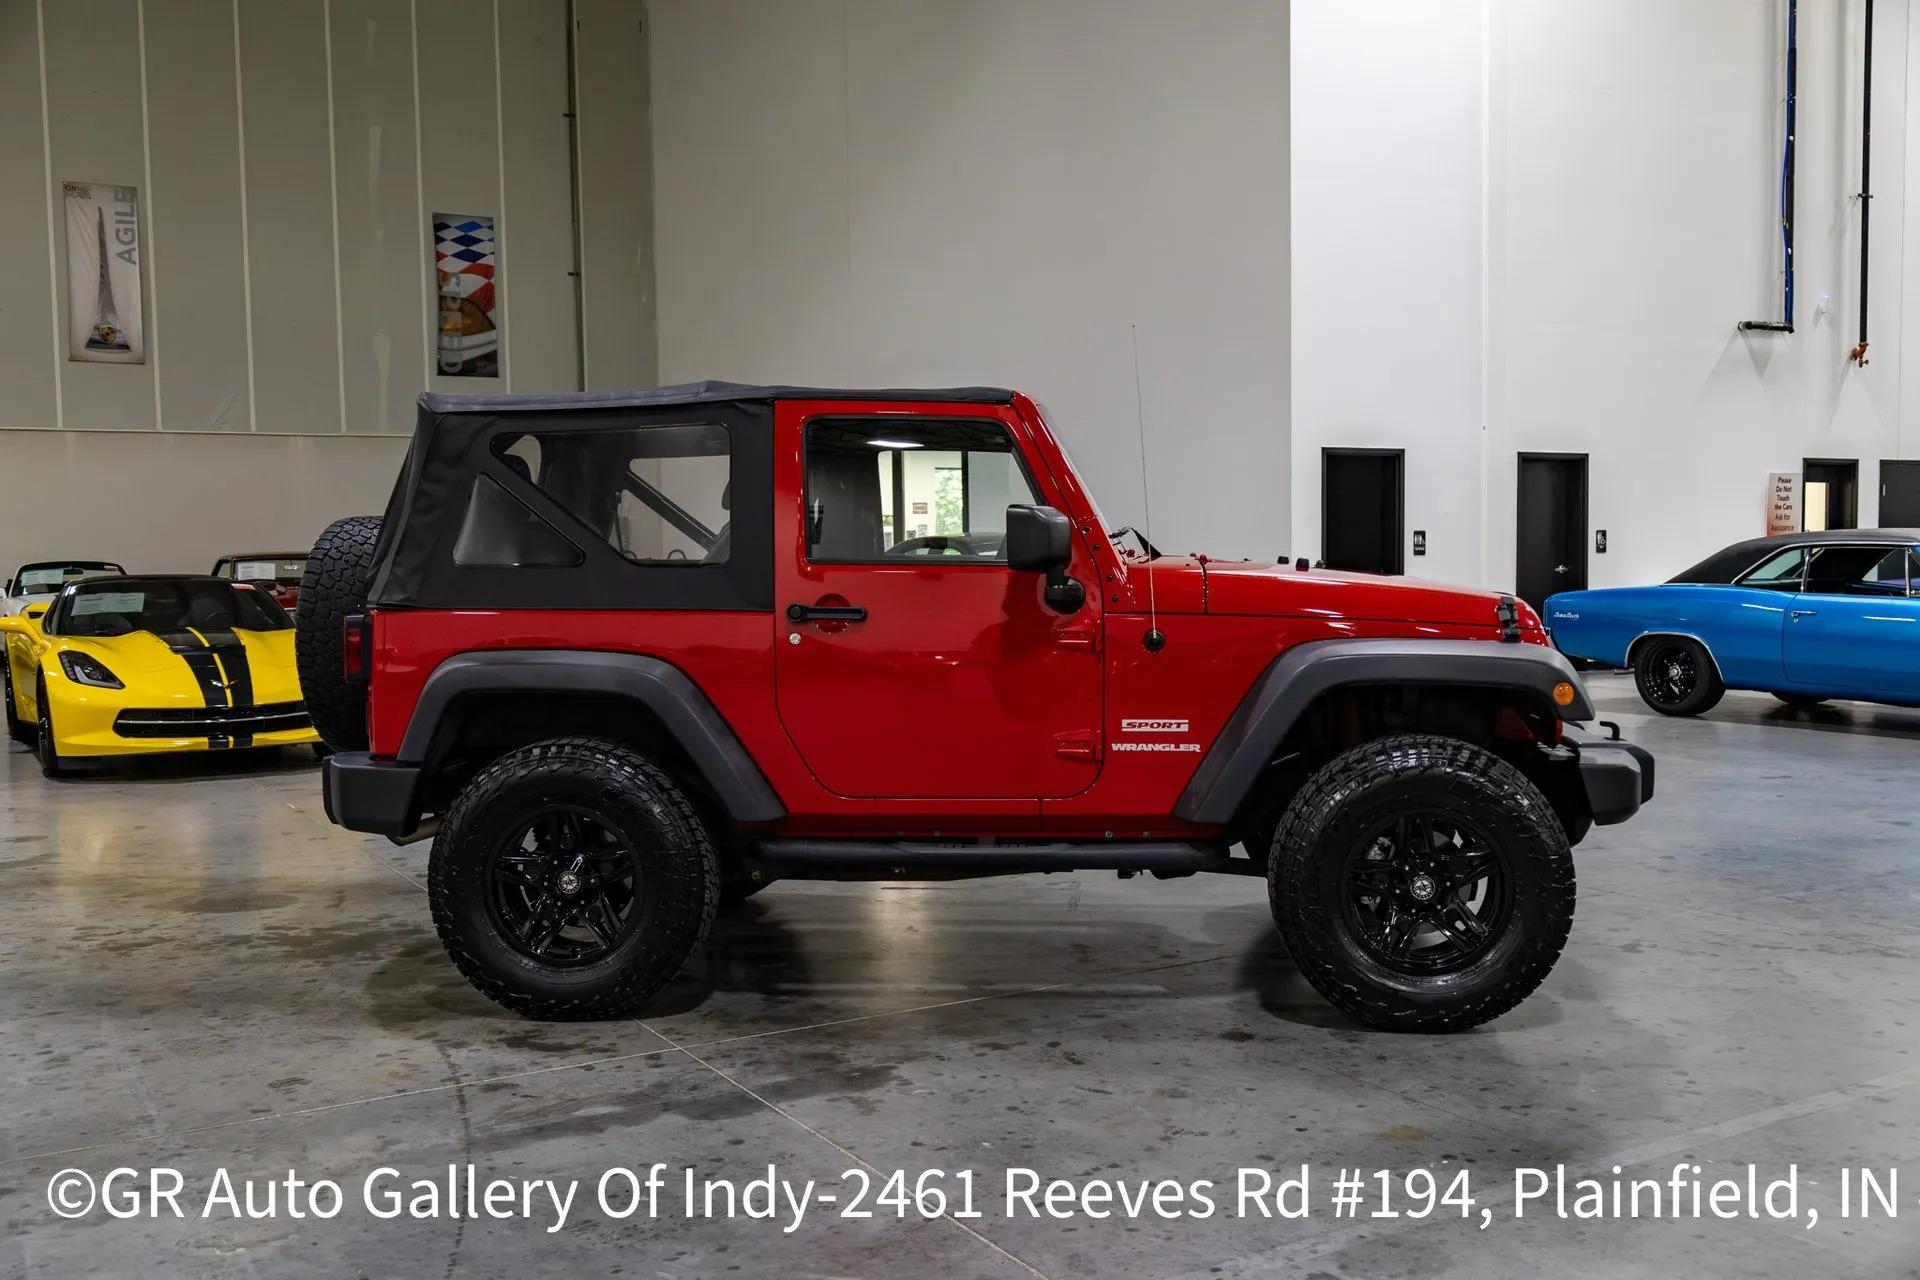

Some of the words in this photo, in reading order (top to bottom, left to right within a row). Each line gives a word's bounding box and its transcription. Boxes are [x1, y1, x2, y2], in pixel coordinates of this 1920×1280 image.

[115, 187, 137, 266] AGILE
[1122, 721, 1188, 730] SPORT
[1111, 743, 1201, 752] WRANGLER
